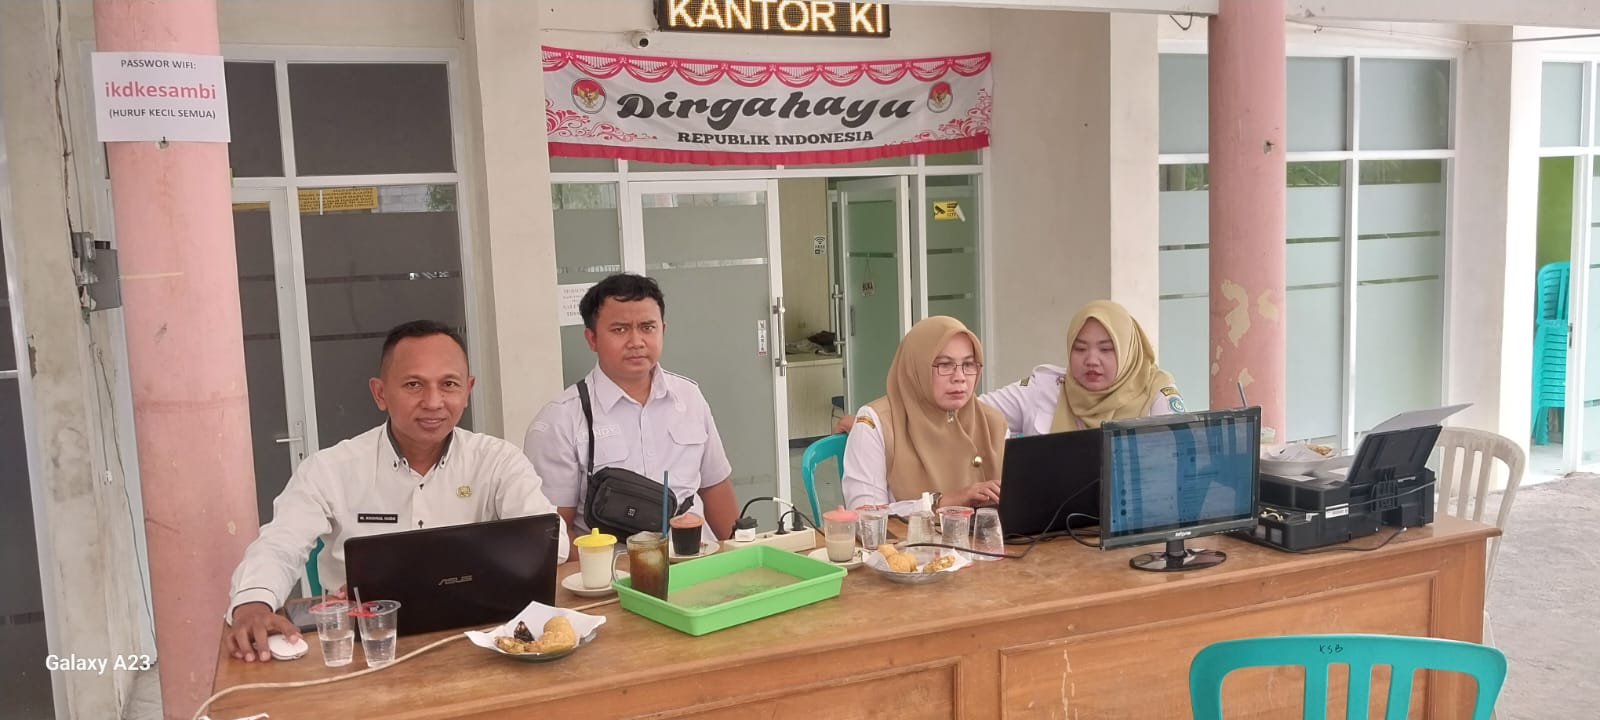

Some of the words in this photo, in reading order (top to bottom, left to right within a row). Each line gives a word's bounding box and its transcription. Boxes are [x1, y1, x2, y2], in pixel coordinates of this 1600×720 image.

[668, 0, 836, 32] KANTOR
[850, 2, 884, 33] KI
[121, 60, 170, 68] PASSWOR
[172, 61, 197, 70] WIFI:
[105, 81, 216, 99] ikdkesambi
[109, 109, 146, 119] (HURUF
[149, 109, 176, 117] KECIL
[178, 110, 216, 119] SEMUA)
[617, 91, 916, 131] Dirgahayu
[678, 131, 770, 146] REPUBLIK
[775, 131, 874, 145] INDONESIA
[438, 575, 473, 586] ASUS
